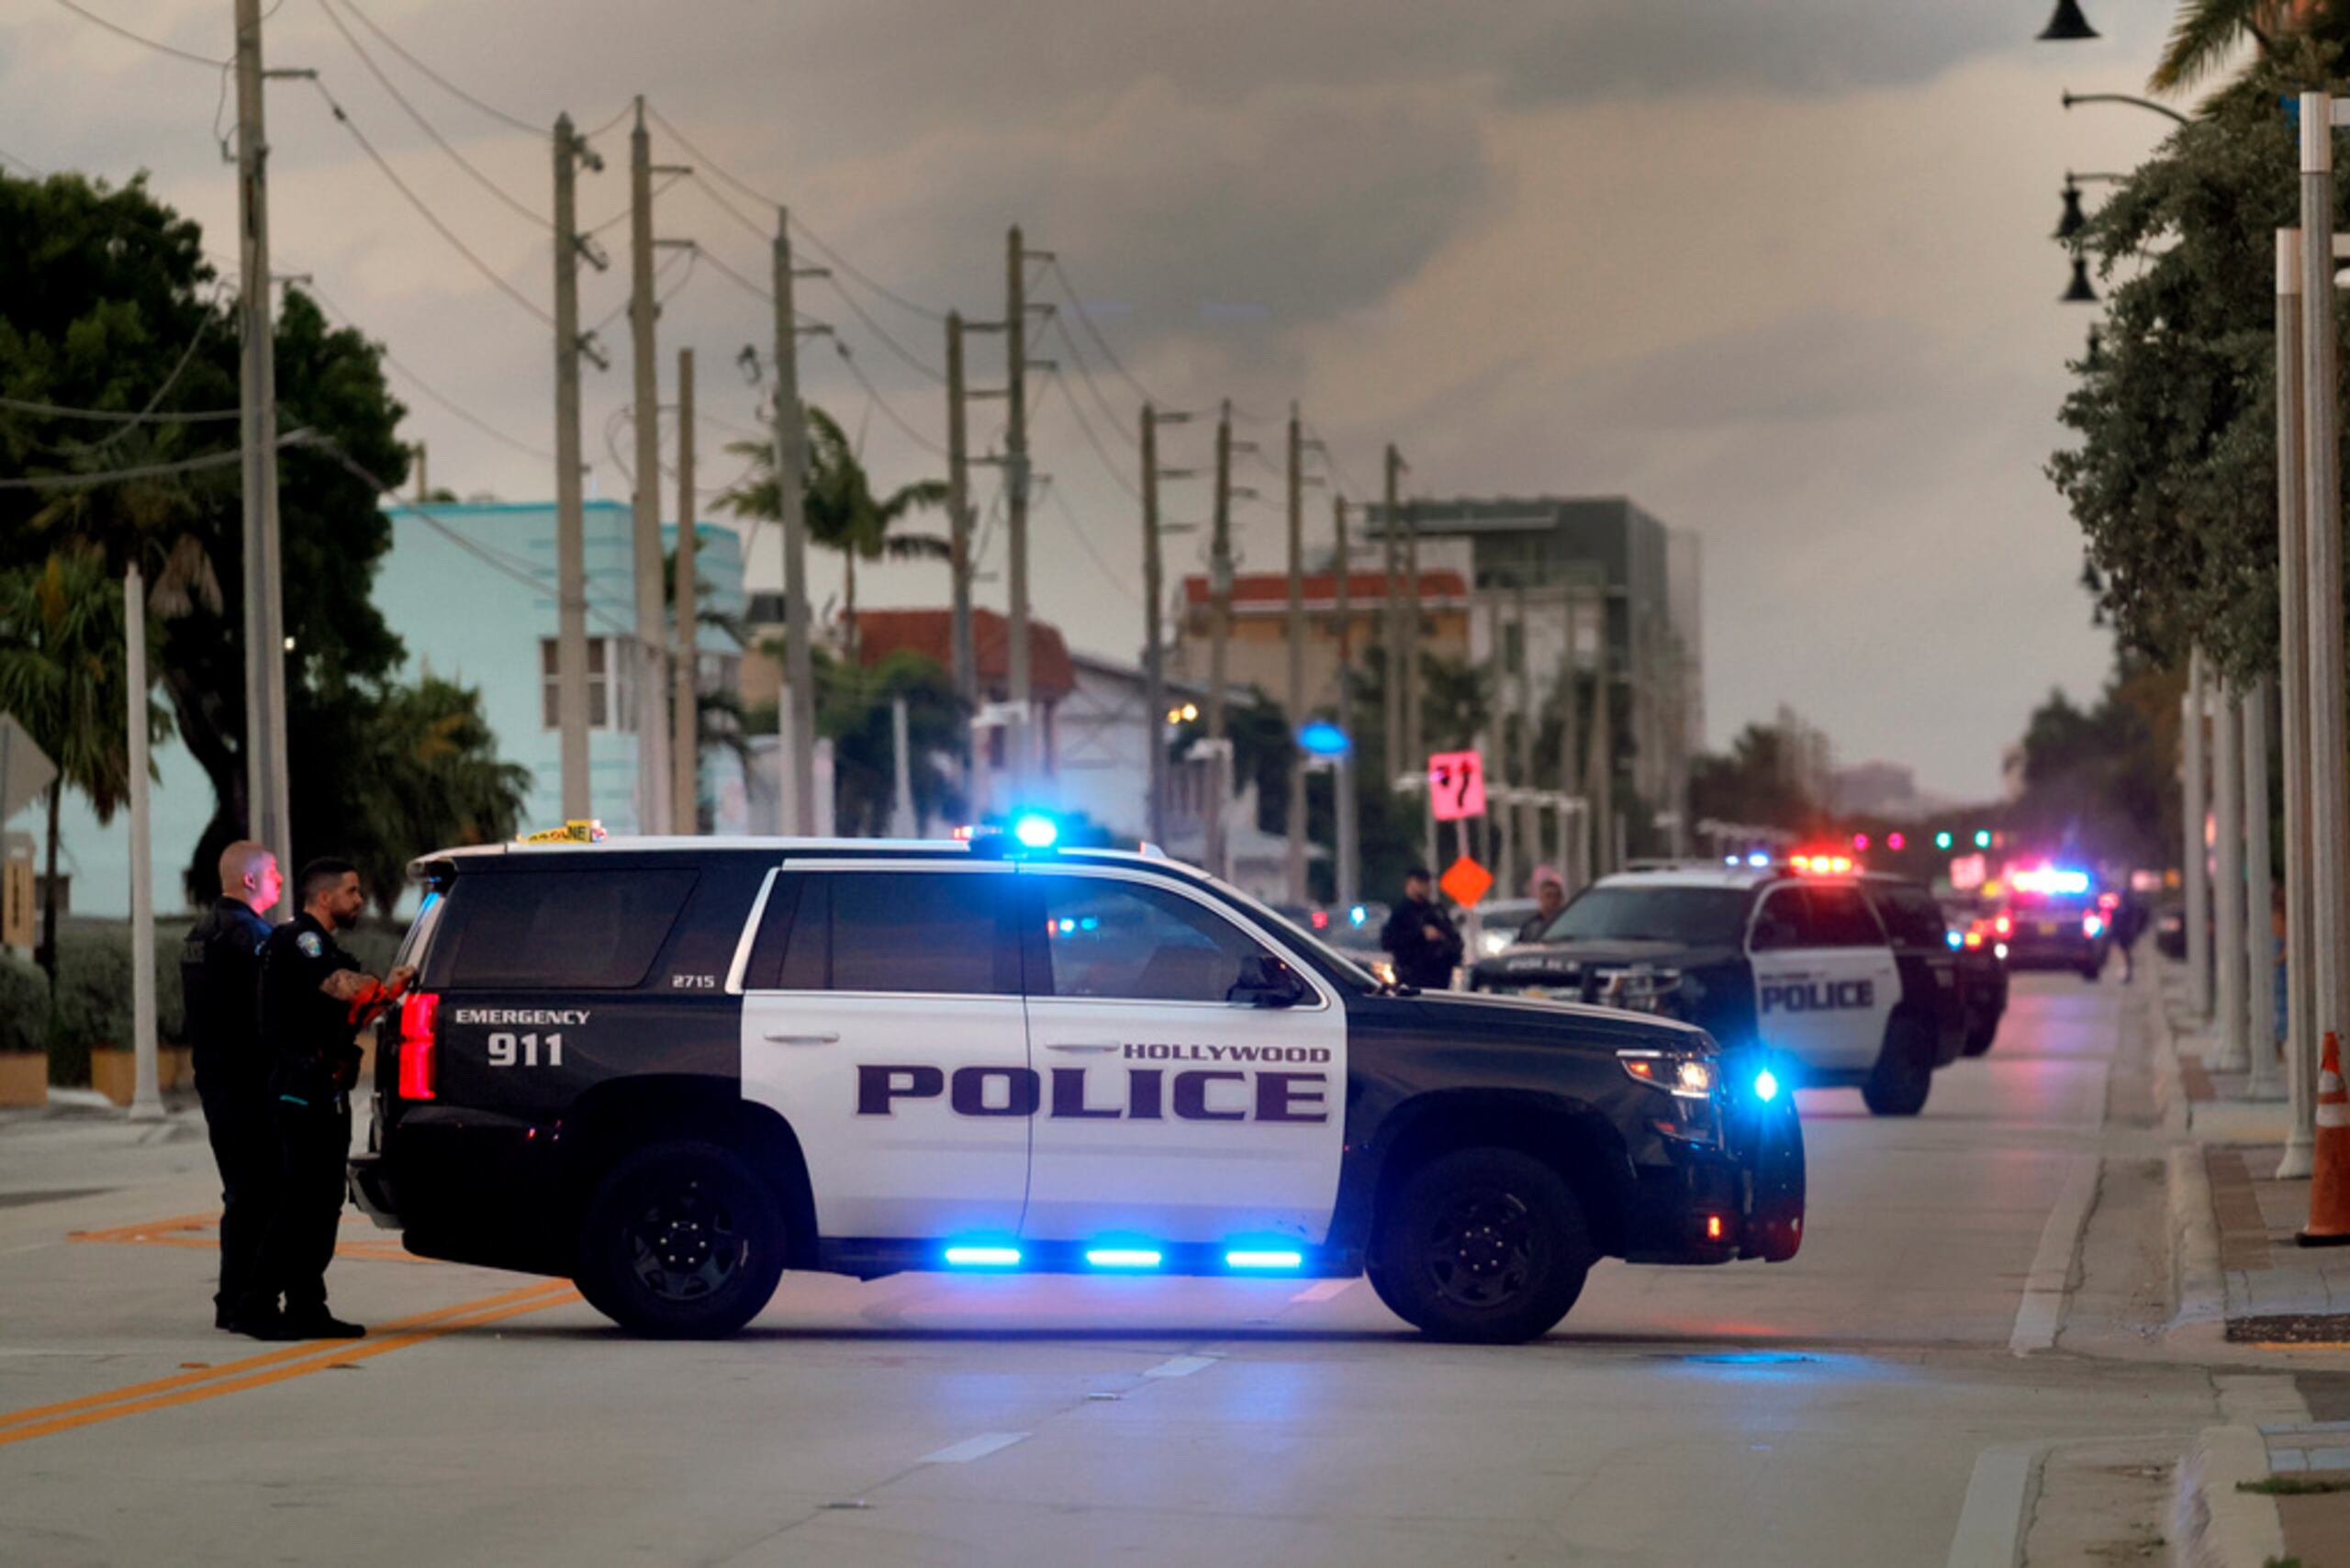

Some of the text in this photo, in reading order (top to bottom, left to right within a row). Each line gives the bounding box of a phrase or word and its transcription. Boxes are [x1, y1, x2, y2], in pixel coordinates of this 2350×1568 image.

[672, 974, 715, 988] 2715
[1762, 980, 1874, 1014] POLICE
[455, 1009, 591, 1025] EMERGENCY
[487, 1032, 563, 1067] 911
[1124, 1044, 1331, 1063] HOLLYWOOD
[856, 1065, 1328, 1123] POLICE
